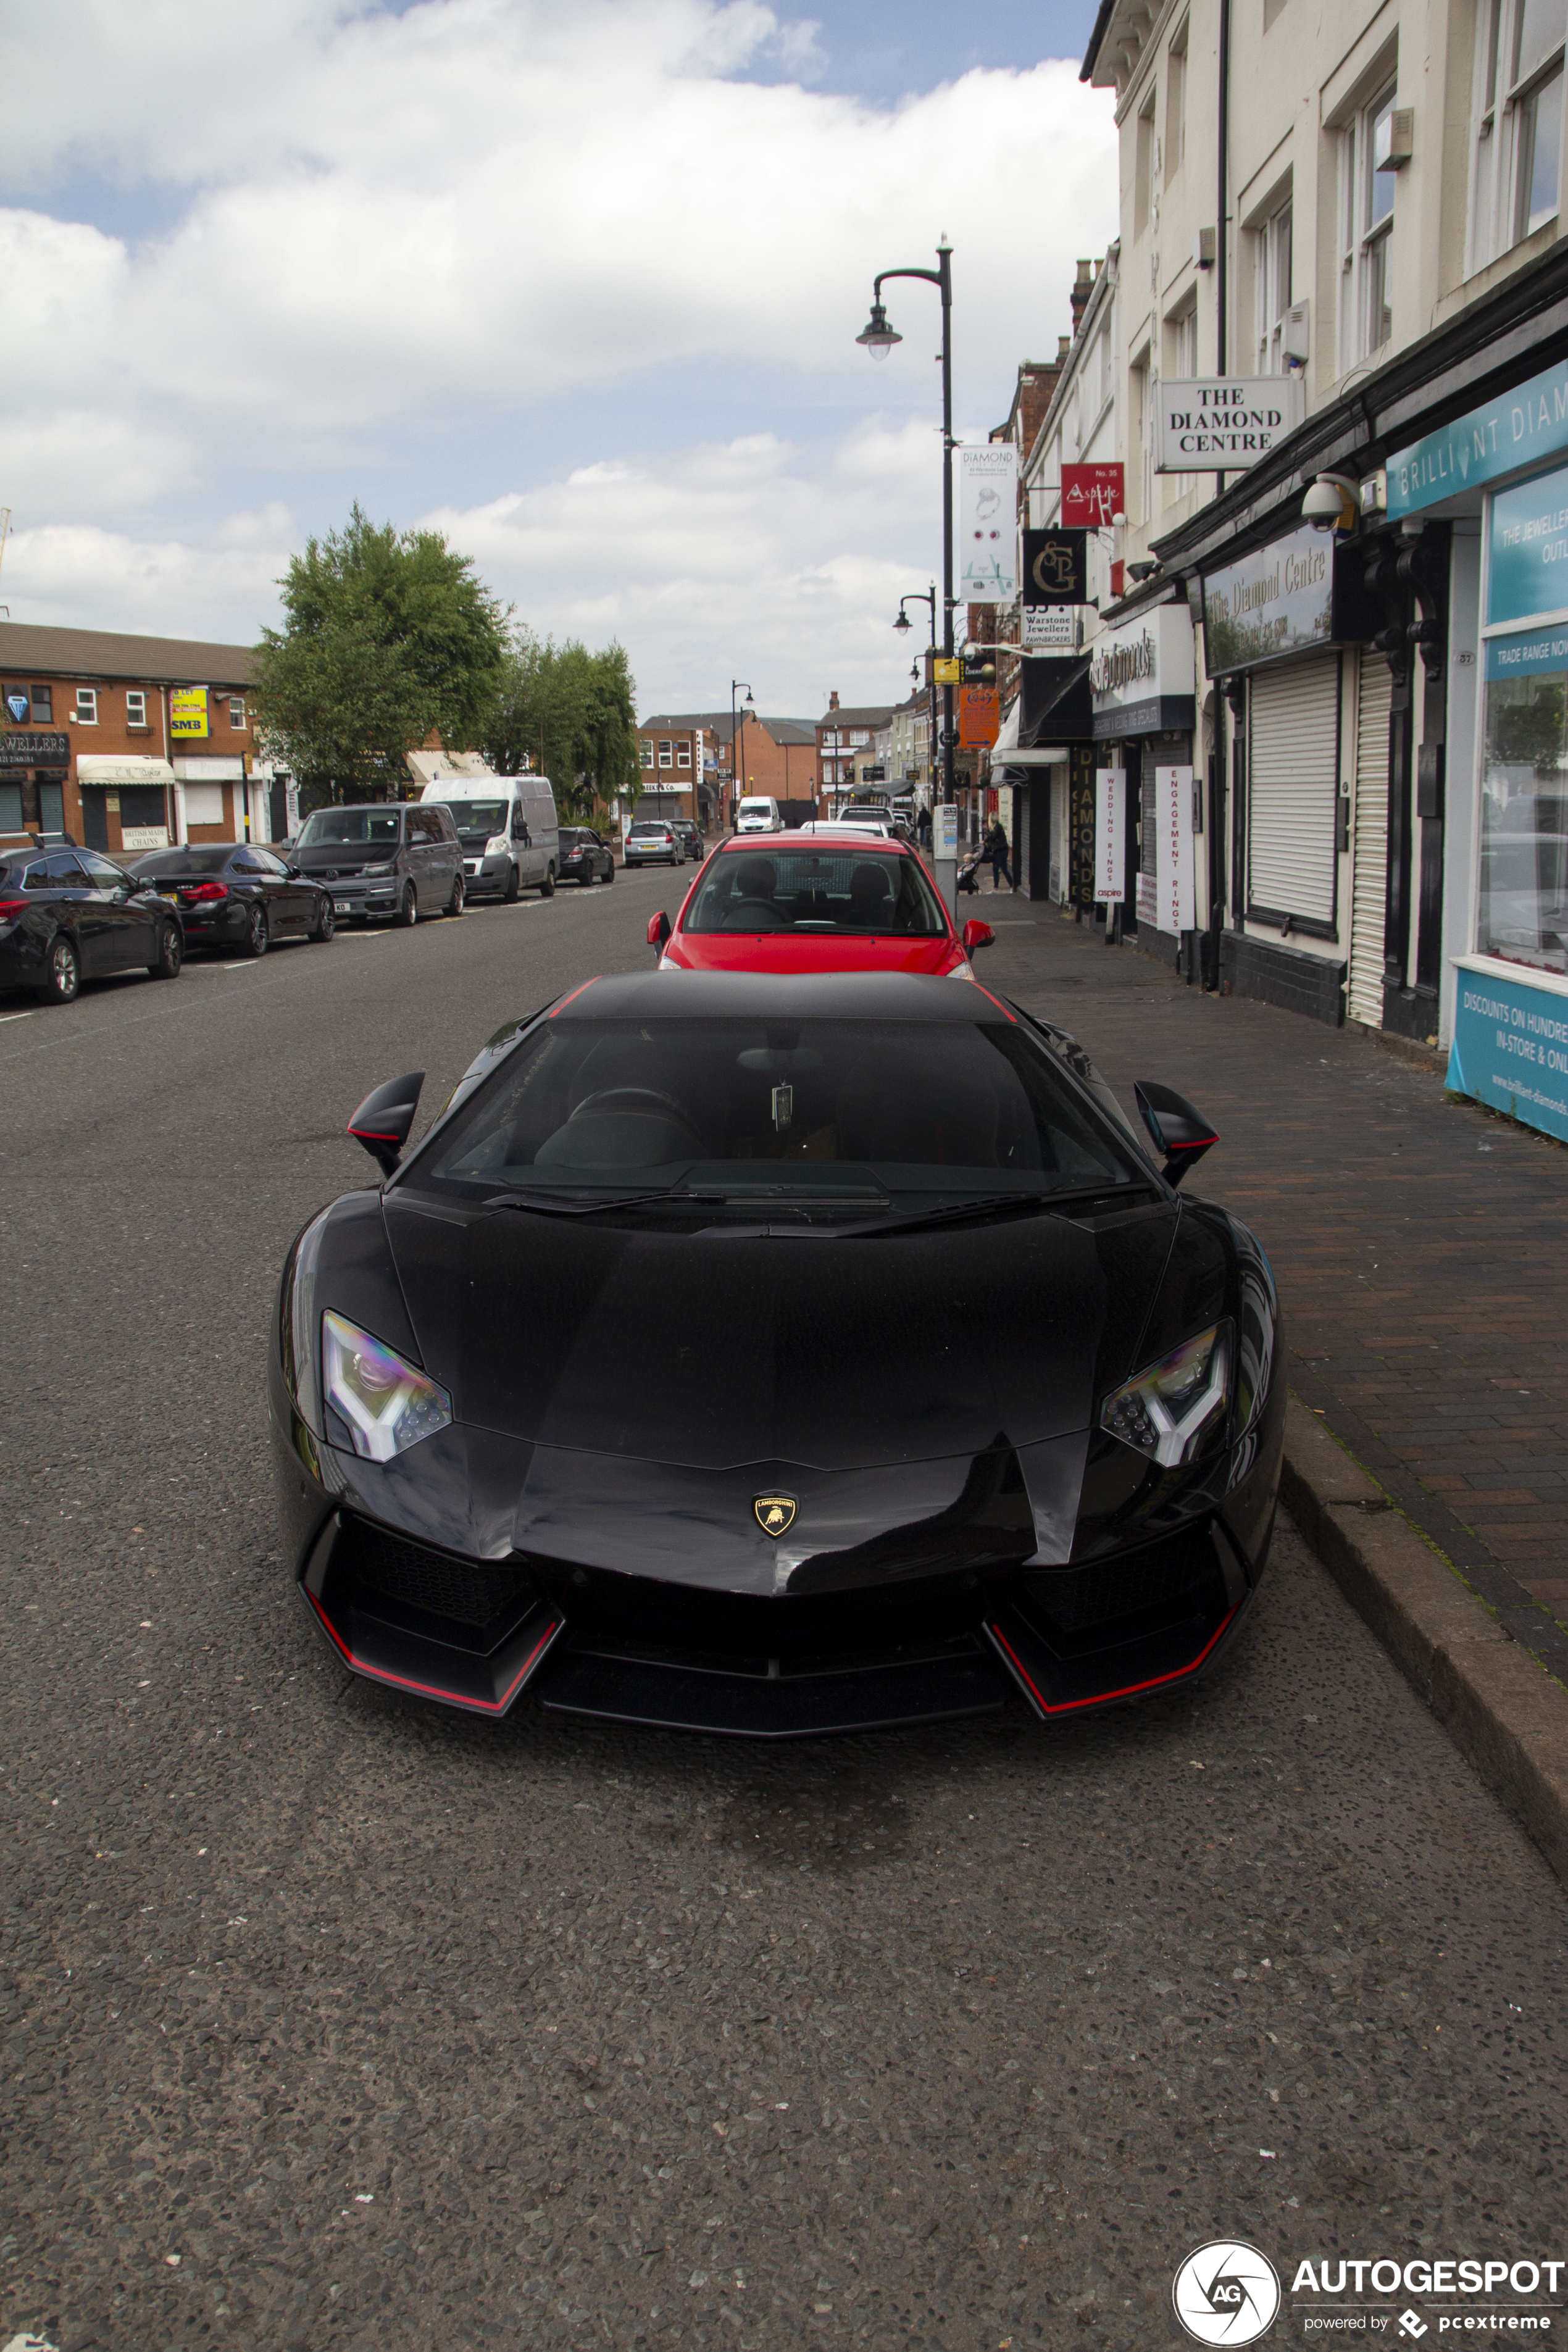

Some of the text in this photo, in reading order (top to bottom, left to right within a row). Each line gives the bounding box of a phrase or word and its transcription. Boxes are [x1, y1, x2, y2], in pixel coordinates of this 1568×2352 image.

[1198, 388, 1245, 407] THE
[1170, 410, 1282, 431] DIAMOND
[1180, 434, 1272, 452] CENTRE
[1401, 419, 1498, 496] BRILLINT
[1503, 527, 1521, 548] THE
[1211, 547, 1325, 625] The Diamond Centre
[1027, 625, 1069, 633] Jewellers
[1026, 635, 1071, 643] PAWNBROKERS
[1459, 654, 1471, 663] 37
[1498, 649, 1521, 665] TRADE
[1523, 643, 1549, 661] RANGE
[171, 720, 201, 730] SMB
[0, 737, 65, 752] WELLERS
[135, 767, 161, 778] Taylor
[1081, 749, 1094, 903] DIAMONDS
[1170, 770, 1180, 868] ENGAGEMENT
[132, 838, 158, 846] CHAINS
[1098, 888, 1122, 898] aspire
[1464, 991, 1509, 1023] DISCOUNTS
[1511, 1007, 1525, 1029] ON
[1496, 1030, 1536, 1061] IN-STORE
[1538, 1046, 1545, 1065] &
